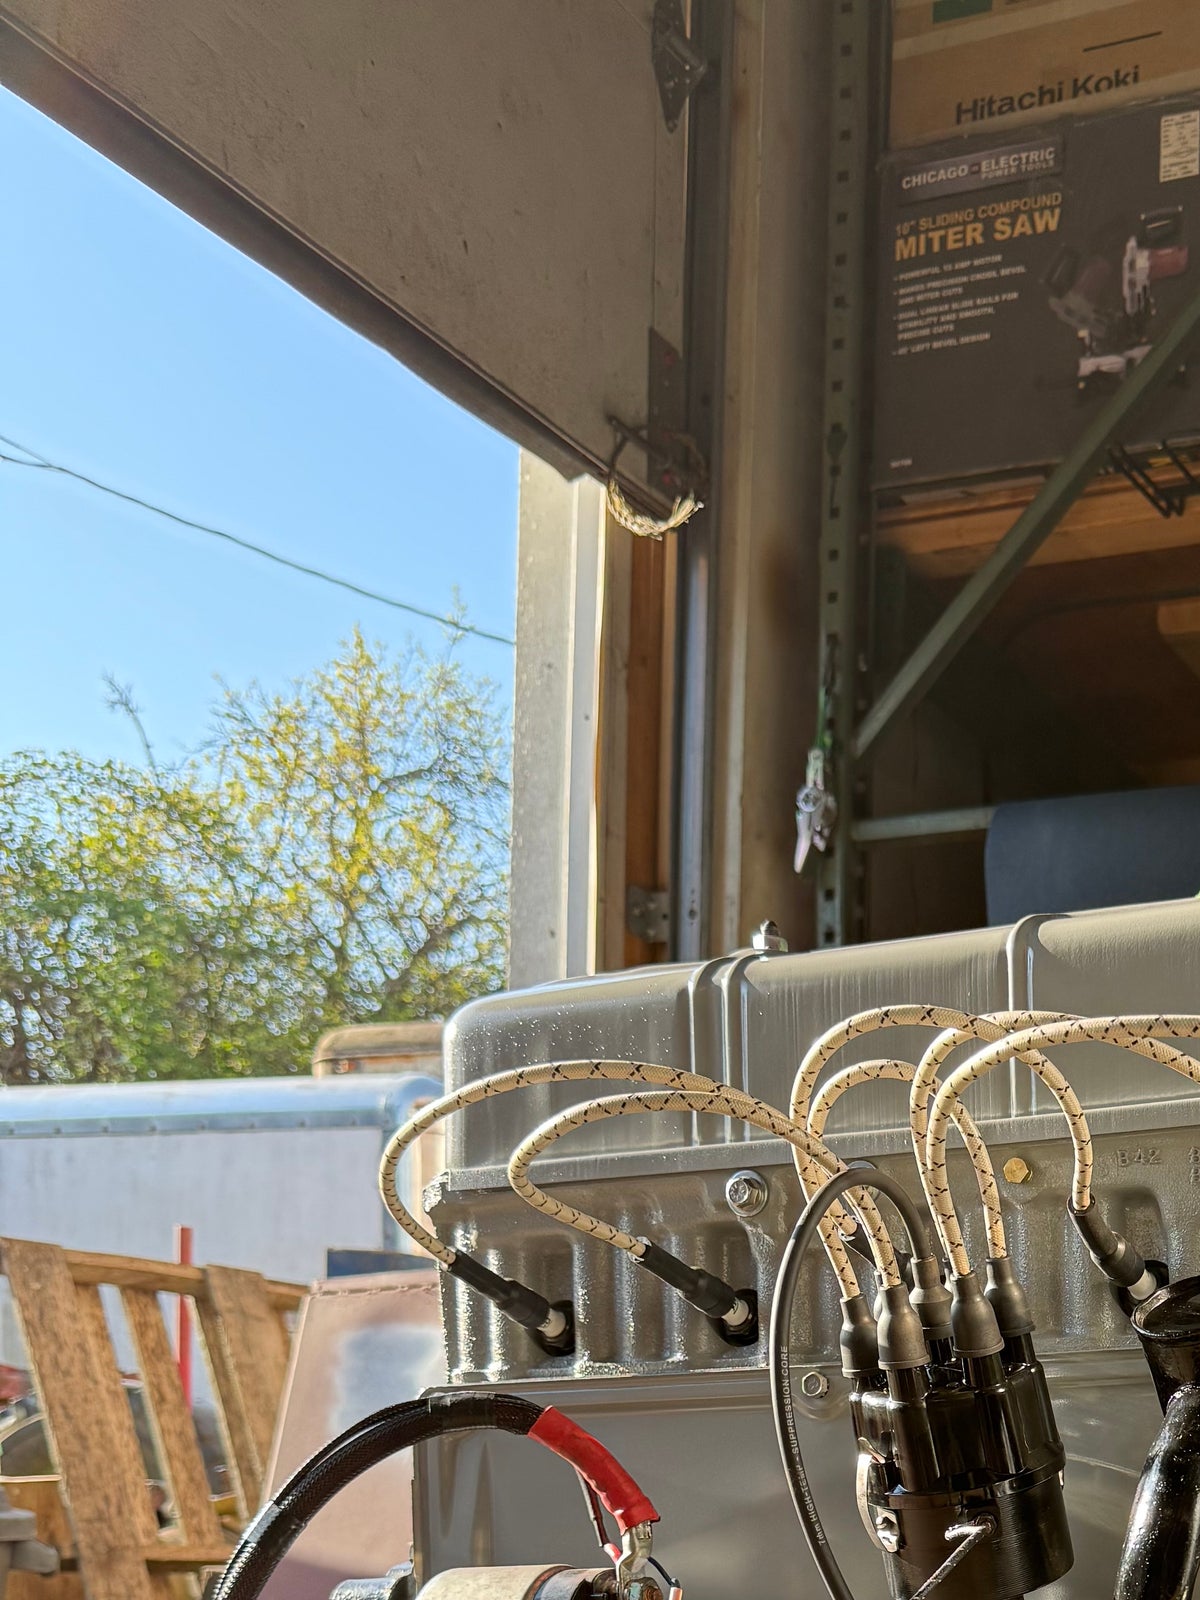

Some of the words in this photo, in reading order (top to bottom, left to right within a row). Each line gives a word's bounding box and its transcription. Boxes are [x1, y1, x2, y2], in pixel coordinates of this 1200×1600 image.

[956, 81, 1063, 125] Hitachi
[1072, 65, 1139, 99] Koki
[902, 165, 968, 189] CHICAGO
[981, 147, 1055, 172] ELECTRIC
[981, 165, 1017, 179] POWER
[1020, 160, 1054, 172] TOOLS
[918, 208, 974, 231] SLIDING
[977, 192, 1062, 219] COMPOUND
[895, 222, 984, 261] MITER
[993, 208, 1061, 241] SAW
[780, 1346, 789, 1376] CORE
[782, 1379, 799, 1454] SUPPRESSION
